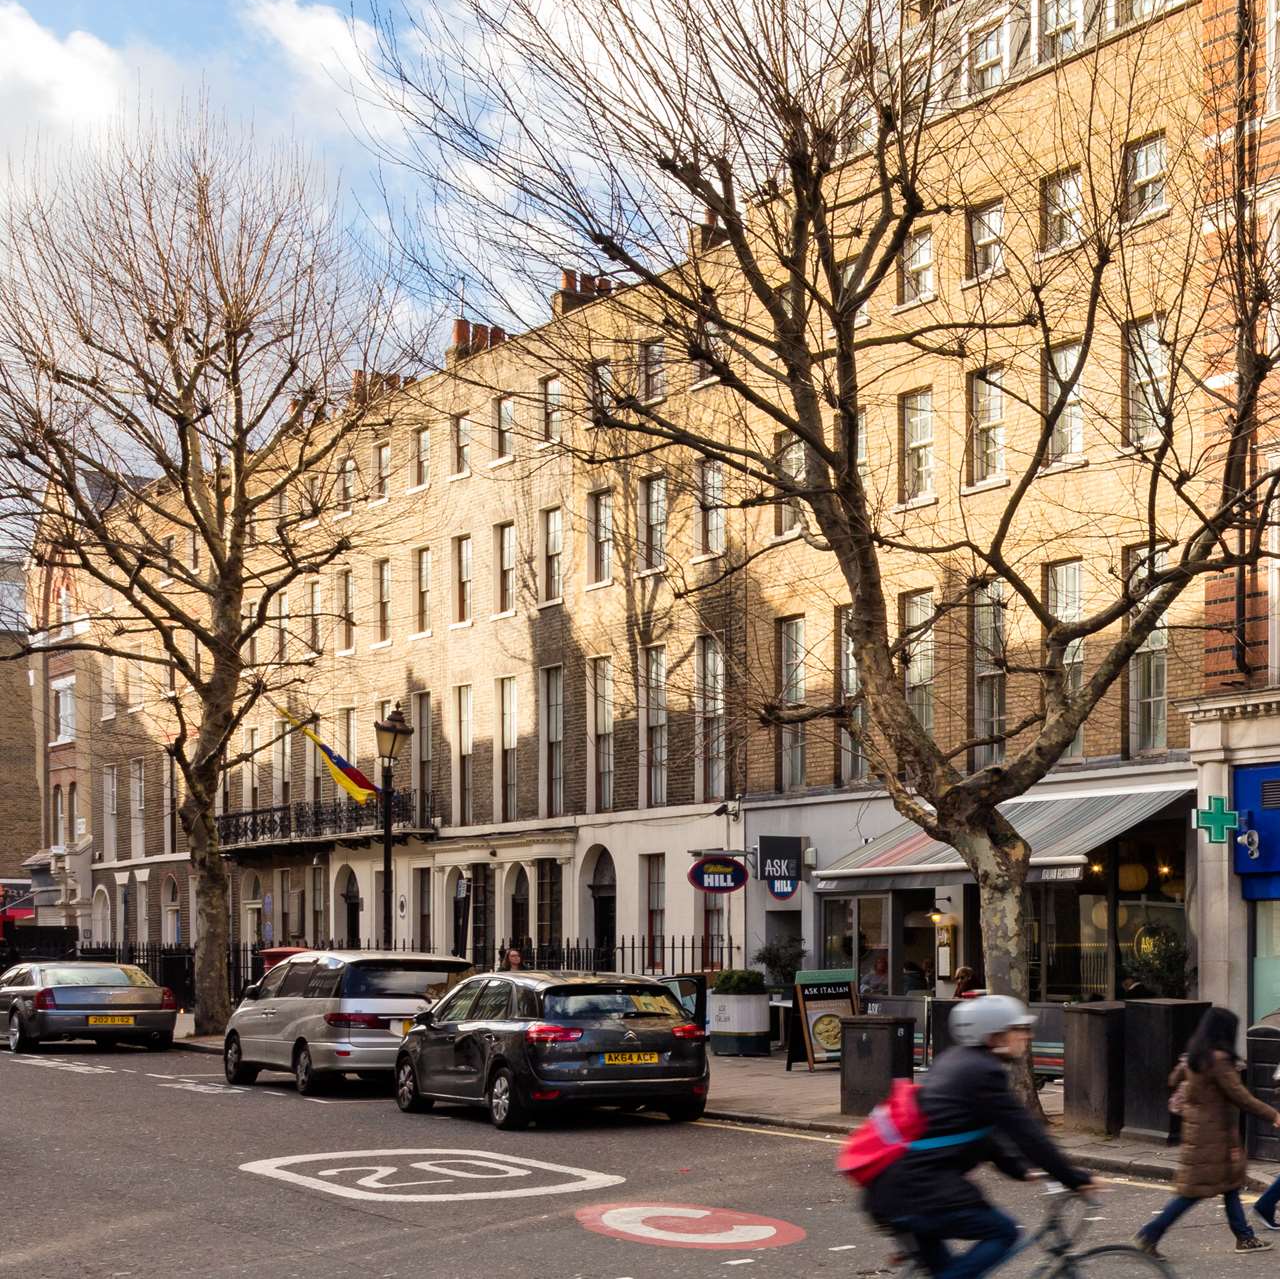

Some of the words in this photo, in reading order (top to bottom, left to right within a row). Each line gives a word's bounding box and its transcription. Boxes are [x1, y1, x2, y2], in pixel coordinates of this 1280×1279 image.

[765, 858, 789, 877] ASK
[703, 874, 734, 887] HILL
[774, 879, 793, 892] HILL
[820, 986, 849, 994] ITALIAN
[867, 1002, 879, 1015] ASK
[607, 1053, 633, 1062] AK64
[317, 1159, 532, 1189] 20
